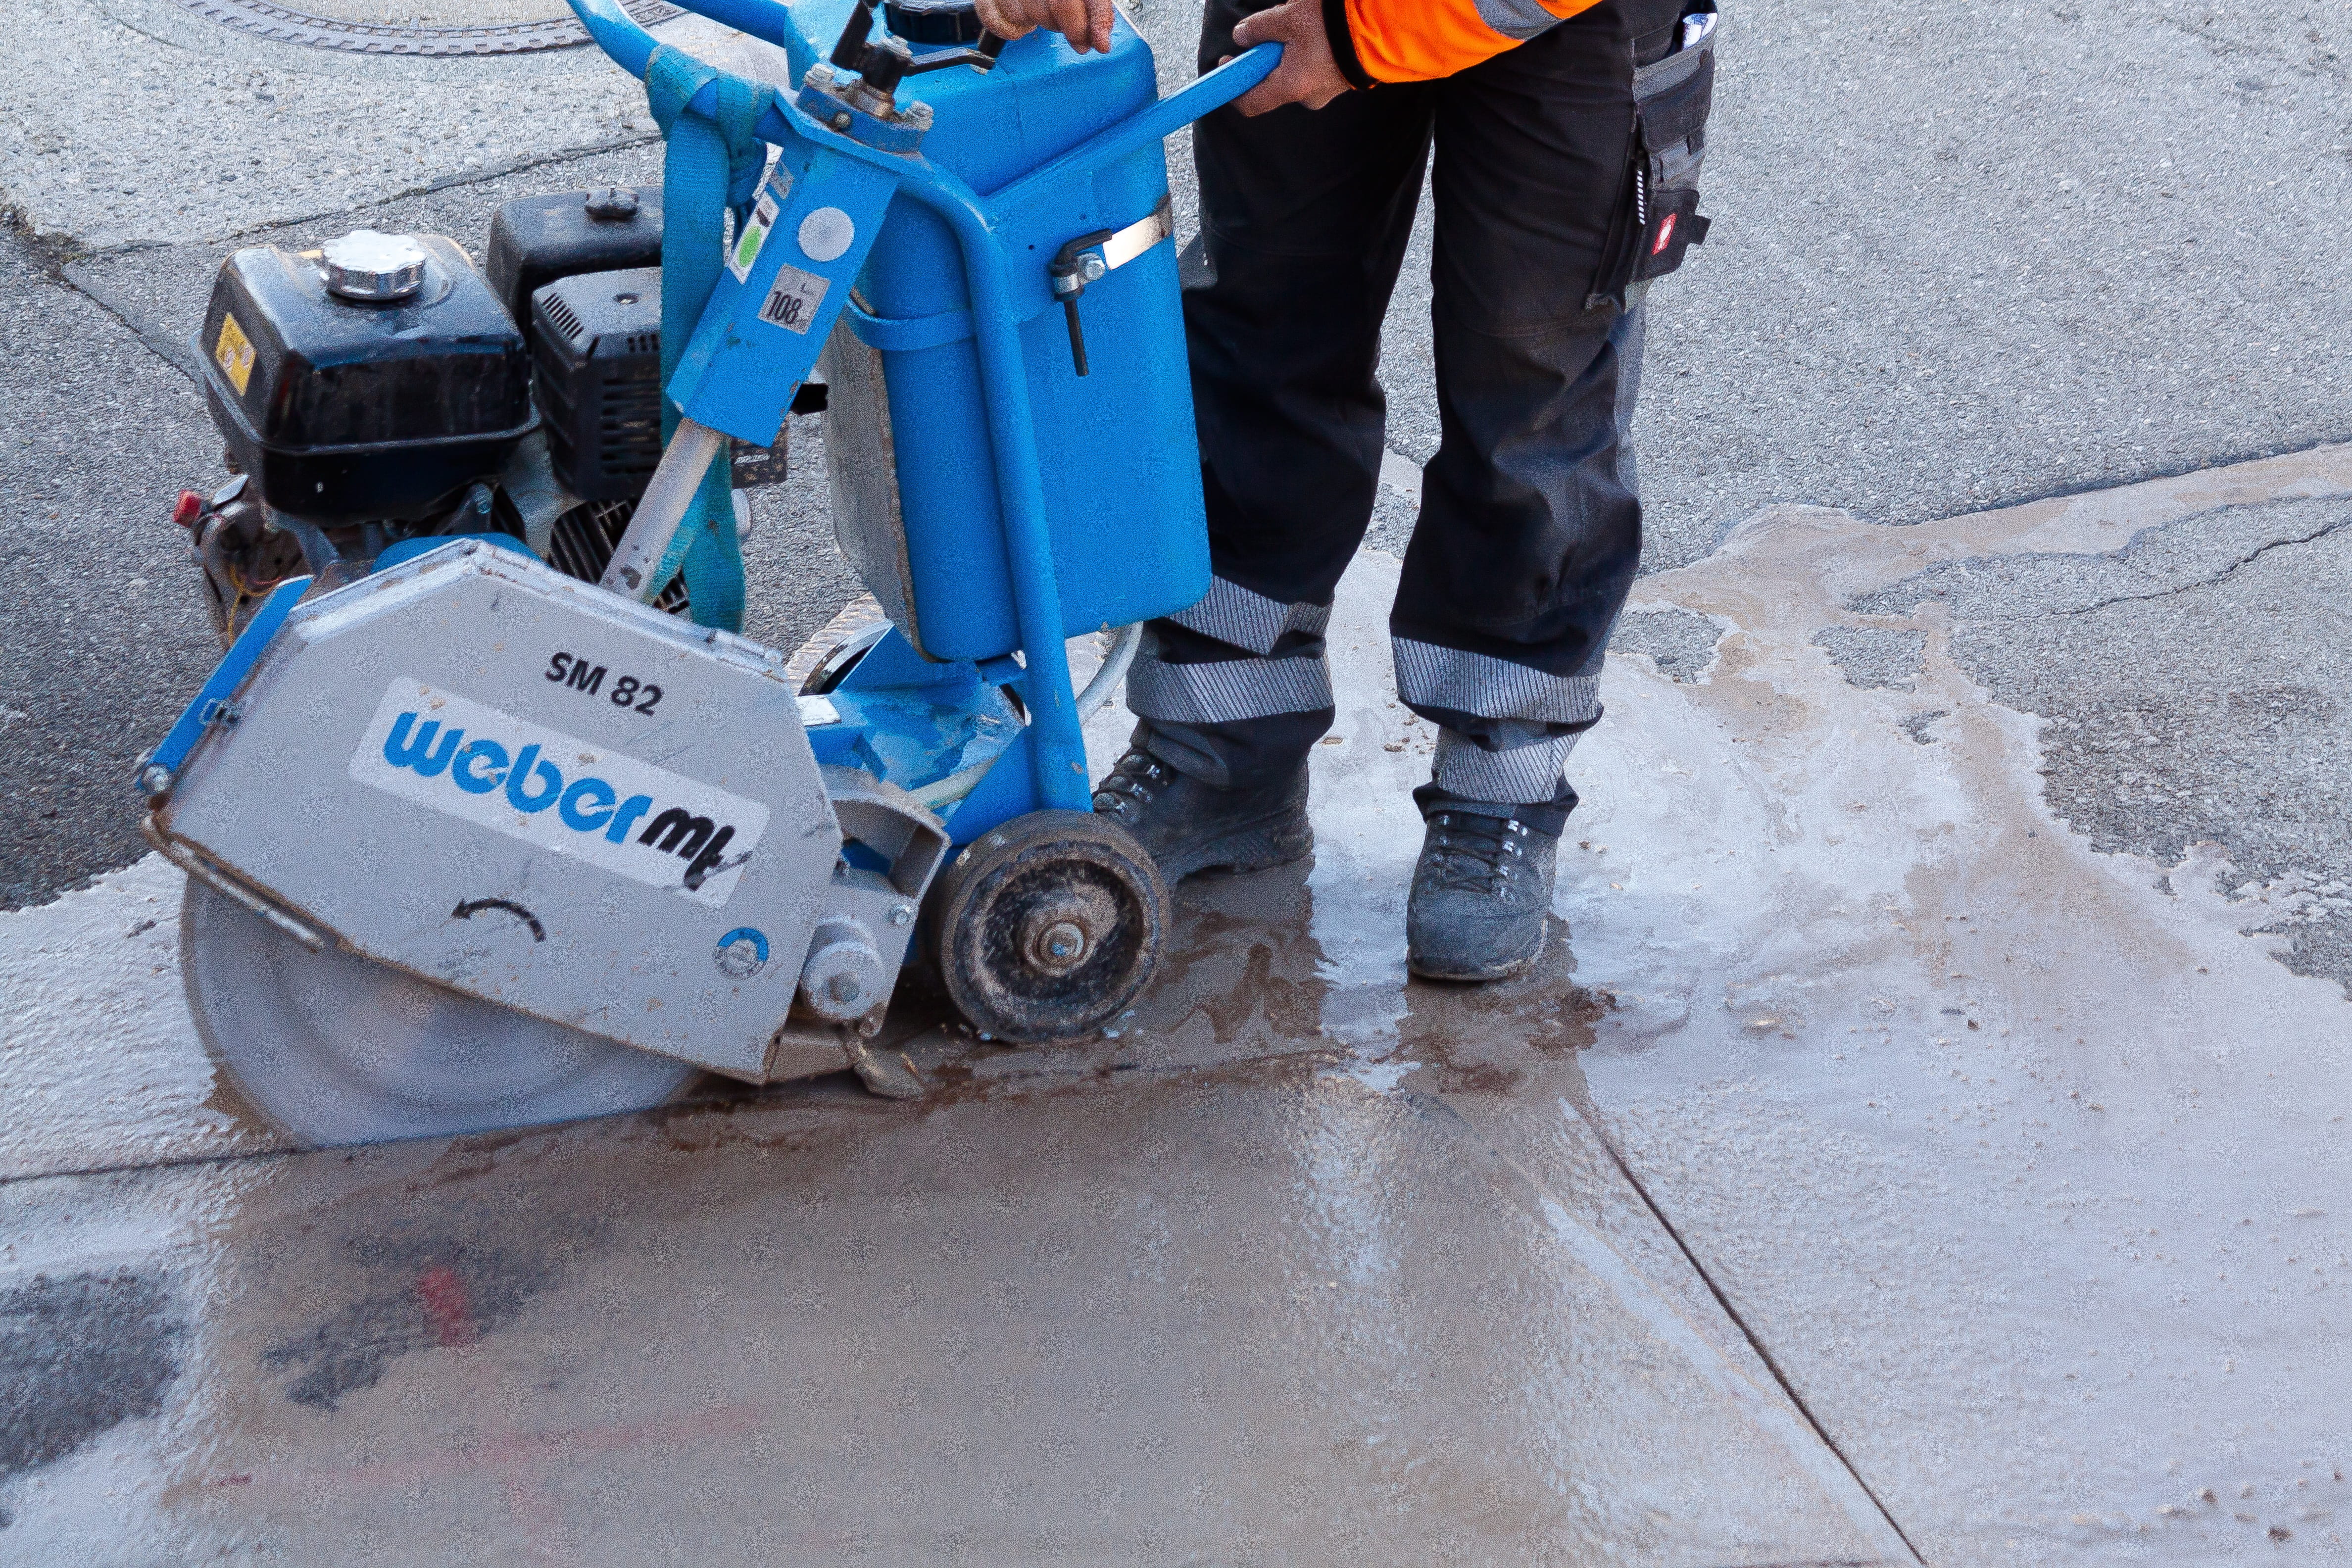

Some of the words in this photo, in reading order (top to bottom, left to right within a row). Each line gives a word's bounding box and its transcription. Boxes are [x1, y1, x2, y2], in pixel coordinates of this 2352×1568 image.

[767, 291, 802, 324] 108
[545, 651, 608, 695] SM
[610, 675, 663, 716] 82
